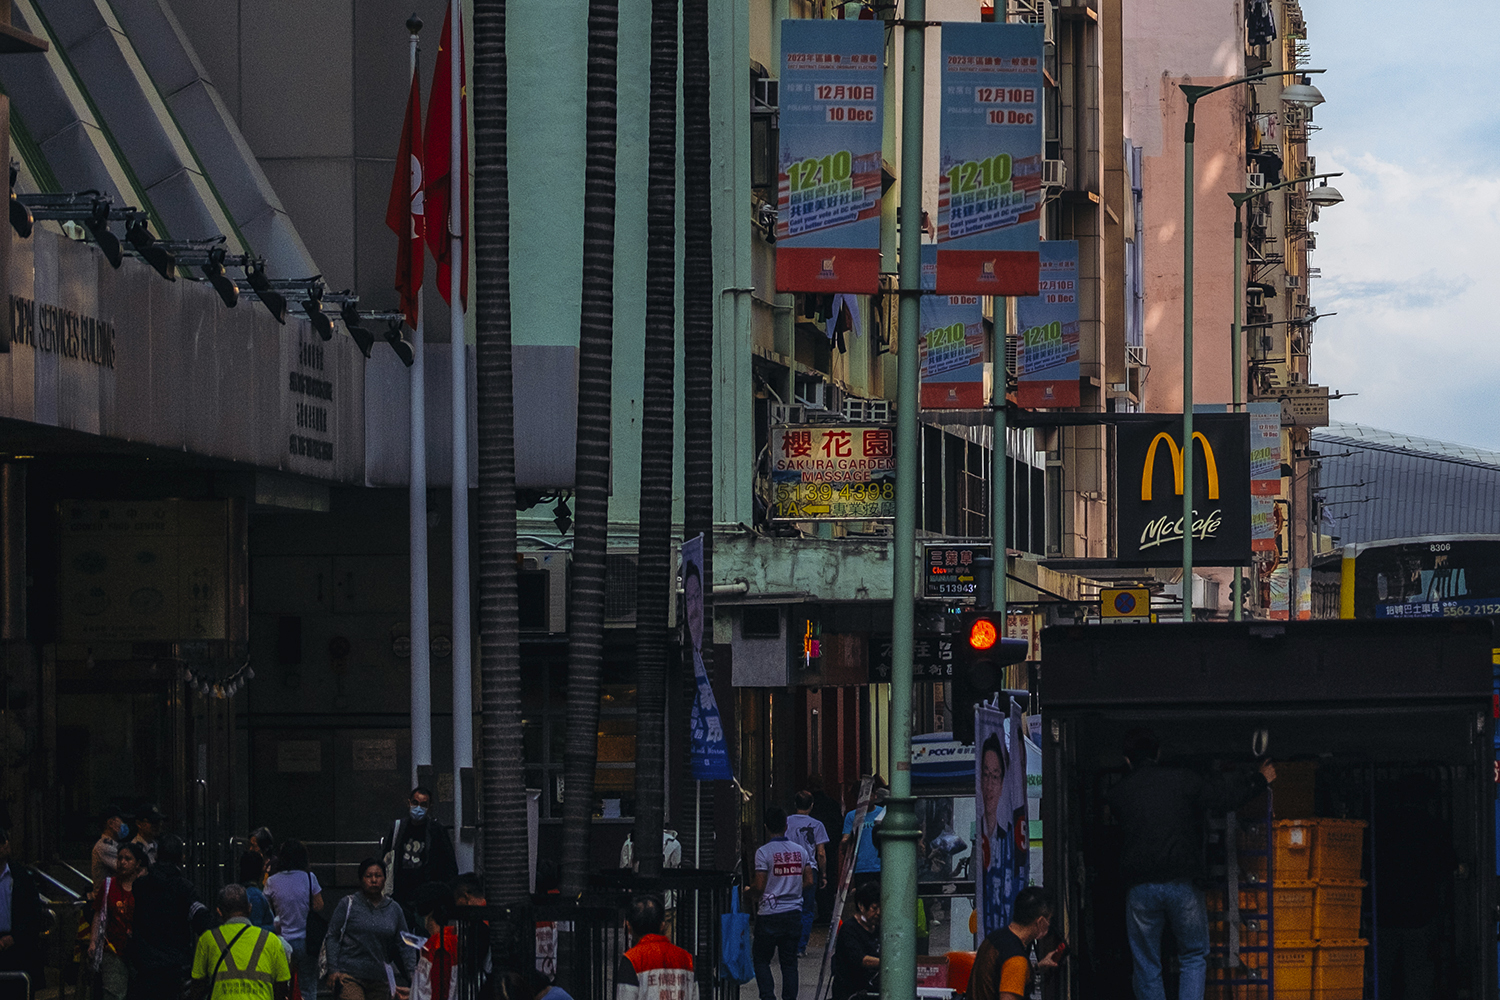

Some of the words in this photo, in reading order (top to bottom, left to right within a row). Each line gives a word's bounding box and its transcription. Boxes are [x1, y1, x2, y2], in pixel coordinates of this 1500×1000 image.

[817, 85, 874, 99] 12月10日
[978, 88, 1034, 102] 12月10日
[829, 107, 844, 121] 10
[848, 107, 873, 121] Dec
[989, 110, 1005, 124] 10
[1008, 110, 1033, 124] Dec
[787, 151, 851, 192] 1210
[947, 153, 1011, 195] 1210
[1040, 281, 1074, 290] 12月10日
[950, 296, 959, 305] 10
[961, 296, 976, 305] Dec
[1047, 294, 1056, 303] 10
[1058, 294, 1073, 303] Dec
[39, 303, 79, 359] SERVICES
[925, 323, 964, 349] 1210
[1023, 321, 1061, 347] 1210
[782, 430, 893, 458] 櫻花園
[777, 460, 835, 470] SAKURA
[838, 459, 897, 470] GARDEN
[802, 471, 872, 482] MASSAGE
[777, 483, 832, 501] 5139
[838, 483, 894, 501] 4398
[776, 502, 800, 516] 1A
[832, 502, 896, 516] 專業按摩
[1139, 509, 1222, 549] McCafé
[930, 550, 973, 566] 三葉草
[940, 584, 977, 593] 513943
[1443, 606, 1471, 617] 5562
[1474, 604, 1500, 615] 2152
[928, 748, 955, 756] PCCW
